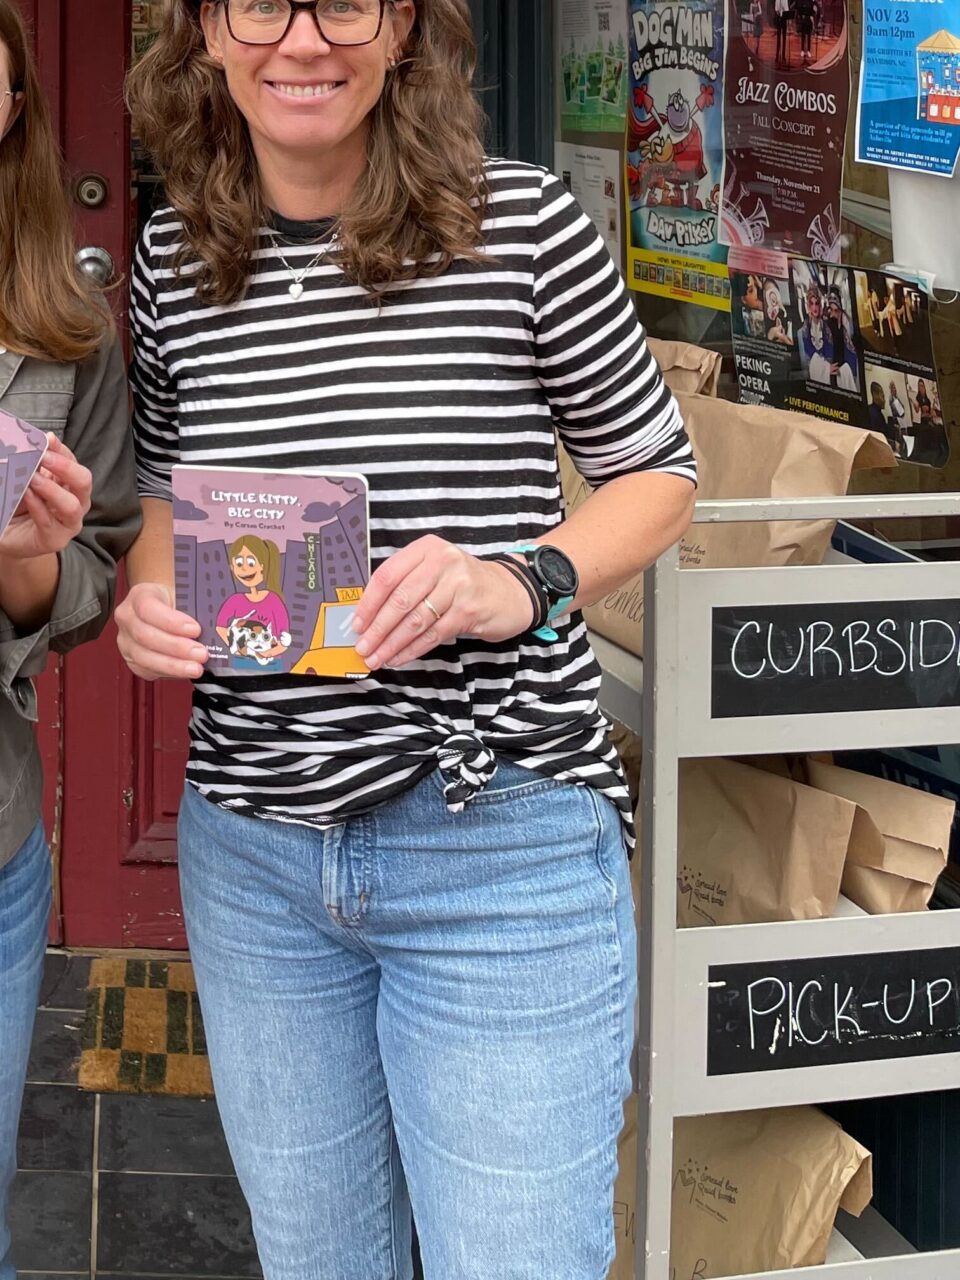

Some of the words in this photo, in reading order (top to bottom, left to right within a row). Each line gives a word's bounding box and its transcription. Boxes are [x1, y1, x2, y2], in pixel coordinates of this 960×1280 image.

[866, 8, 892, 23] NOV
[895, 9, 910, 24] 23
[631, 6, 673, 52] DOG
[675, 6, 713, 48] MAN
[735, 76, 771, 104] JAZZ
[774, 81, 837, 115] COMBOS
[752, 112, 771, 128] FALL
[771, 116, 816, 137] CONCERT
[755, 171, 783, 186] Thursday,
[783, 178, 813, 193] November
[813, 184, 821, 194] 21
[647, 211, 674, 242] DAV
[735, 354, 772, 376] PEKING
[739, 373, 772, 395] OPERA
[788, 397, 802, 409] LIVE
[801, 400, 850, 422] PERFORMANCE!
[211, 490, 257, 503] LITTLE
[258, 493, 302, 507] KITTY,
[224, 521, 234, 529] By
[227, 506, 252, 518] BIG
[253, 508, 286, 520] CITY
[306, 534, 317, 591] CHICAGO
[339, 587, 361, 600] TAXI
[731, 618, 960, 679] CURBSID
[747, 976, 952, 1051] PICK-UP
